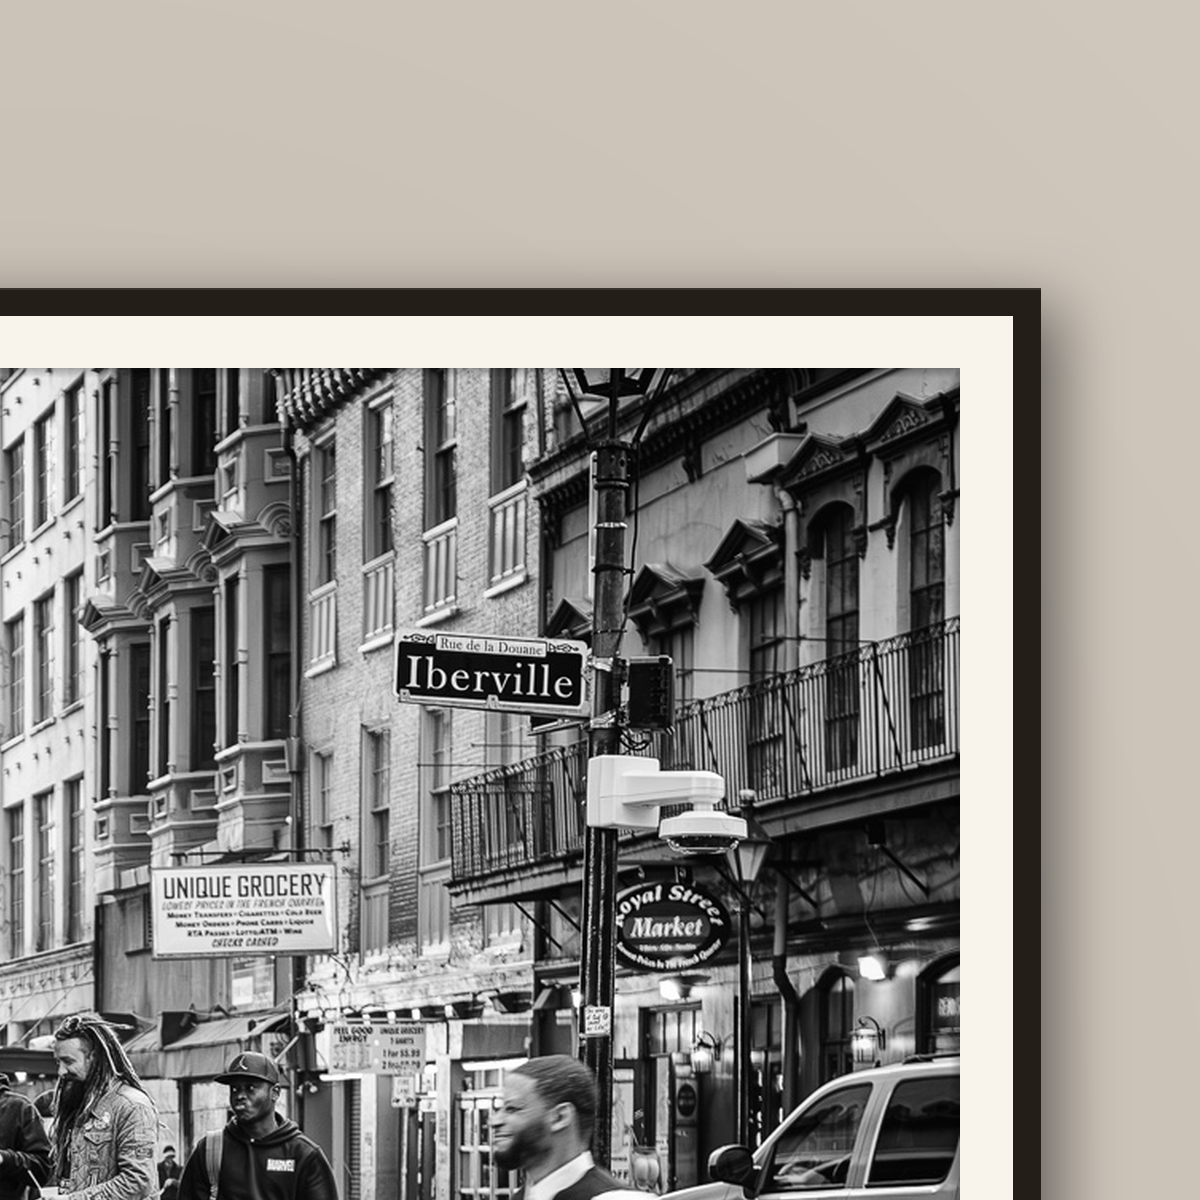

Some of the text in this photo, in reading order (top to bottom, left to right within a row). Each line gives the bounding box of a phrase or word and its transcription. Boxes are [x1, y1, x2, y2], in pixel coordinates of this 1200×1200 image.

[440, 637, 543, 656] Rue de la Douane
[405, 655, 573, 698] Iberville
[163, 873, 325, 899] UNIQUE GROCERY
[668, 885, 724, 926] Street
[630, 915, 704, 938] Market
